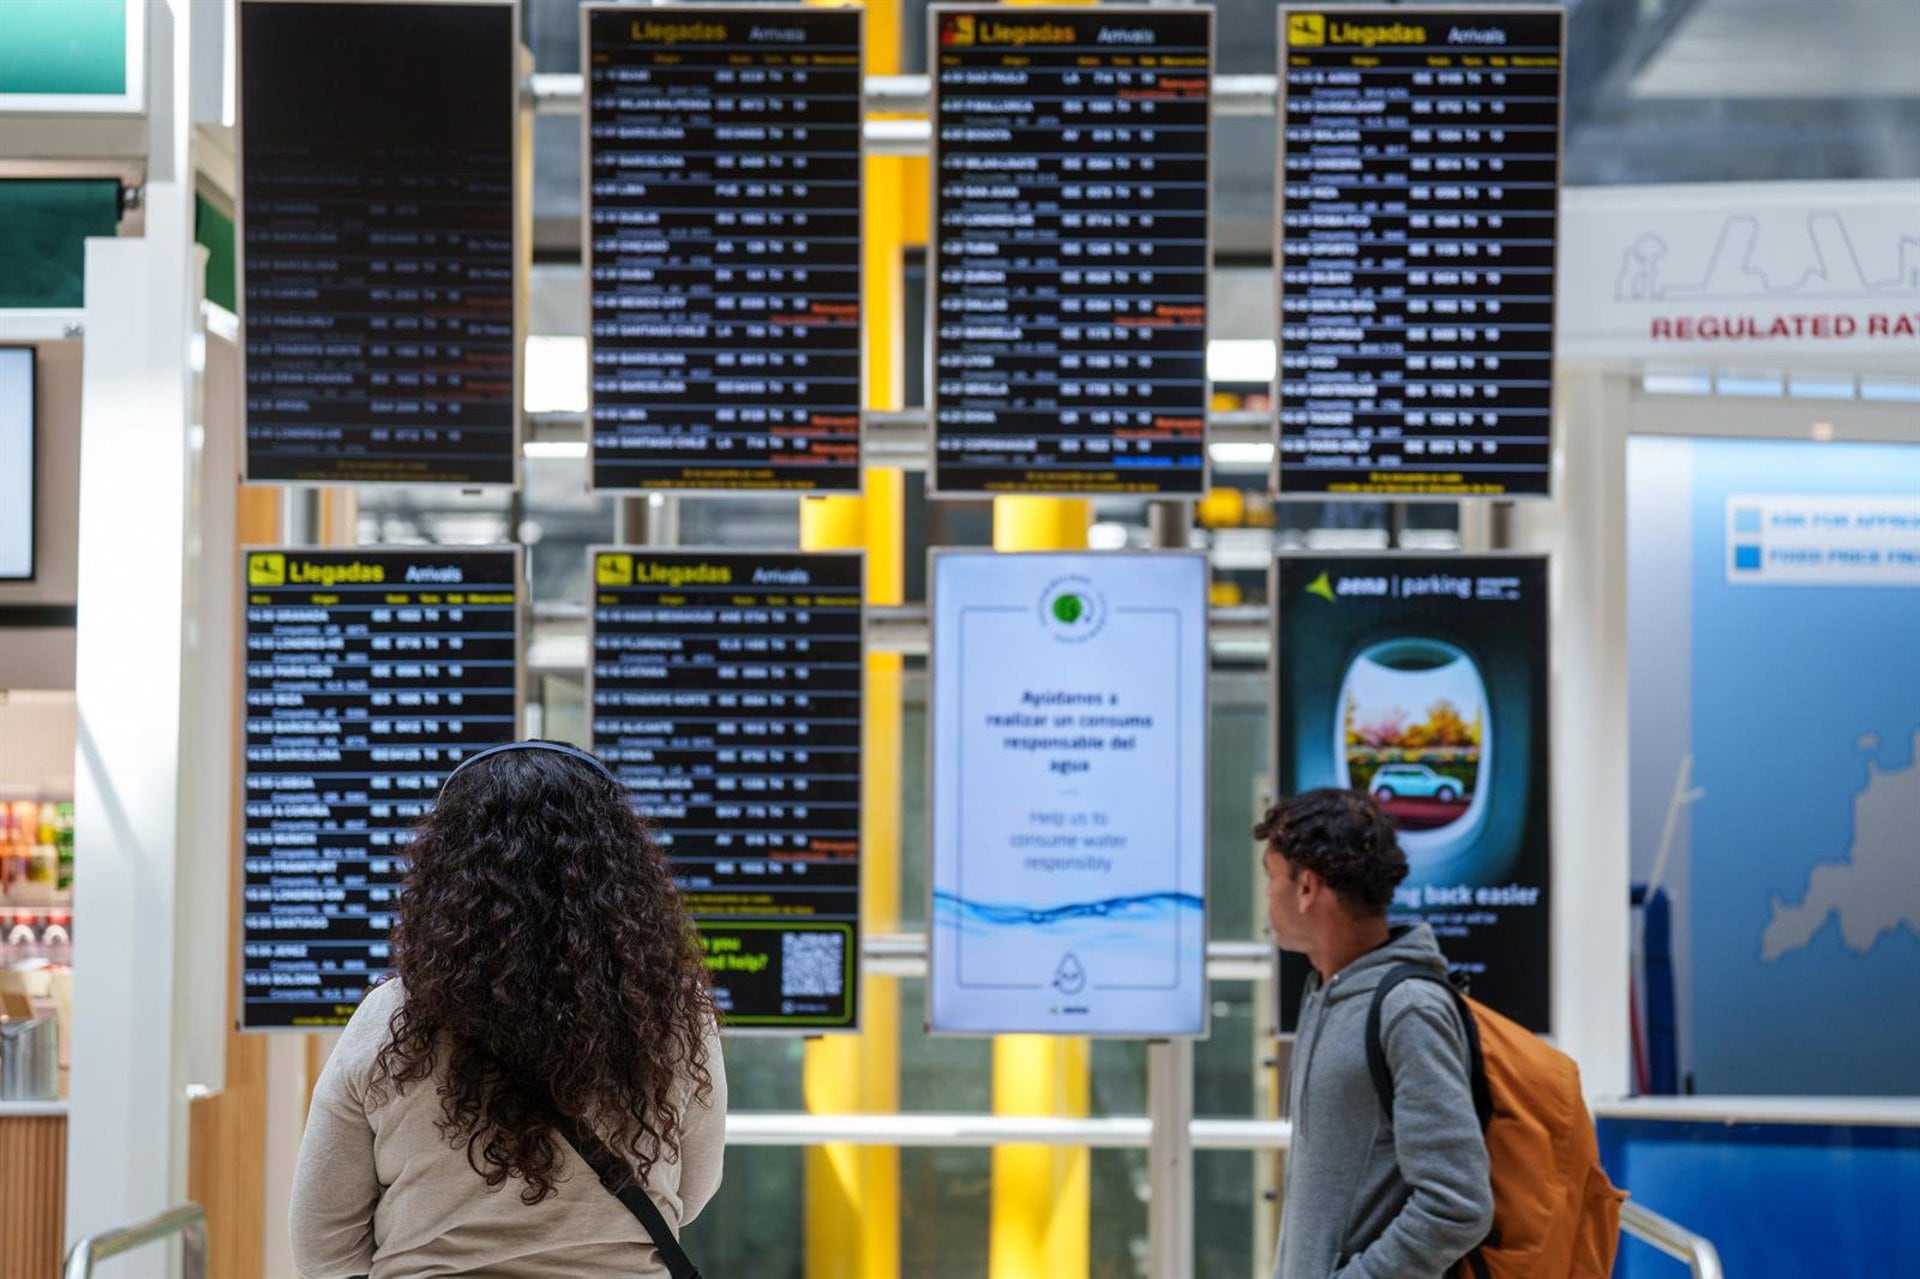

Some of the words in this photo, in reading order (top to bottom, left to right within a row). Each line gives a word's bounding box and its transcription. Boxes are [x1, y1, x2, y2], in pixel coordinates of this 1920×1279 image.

[631, 21, 727, 44] Llegadas
[749, 25, 806, 42] Arrivals
[980, 22, 1076, 46] Llegadas
[1098, 27, 1155, 43] Arrivals
[1329, 22, 1426, 47] Llegadas
[1448, 26, 1506, 44] Arrivals
[1651, 314, 1857, 342] REGULATED
[290, 560, 385, 586] Llegadas
[405, 565, 463, 583] Arrivals
[637, 561, 731, 587] Llegadas
[752, 566, 809, 584] Arrivals
[1401, 574, 1472, 599] parking
[986, 713, 1047, 728] realizar
[1052, 716, 1074, 728] un
[1003, 735, 1105, 752] responsable
[1110, 735, 1137, 750] del
[1048, 760, 1090, 775] agua
[1029, 811, 1065, 827] Help
[1069, 813, 1088, 826] us
[1091, 811, 1109, 826] to
[1009, 835, 1079, 848] consume
[1083, 834, 1128, 848] water
[1023, 856, 1113, 874] responsibly
[1424, 883, 1473, 905] back
[1475, 883, 1540, 906] easier
[712, 938, 741, 953] you
[727, 953, 769, 973] help?
